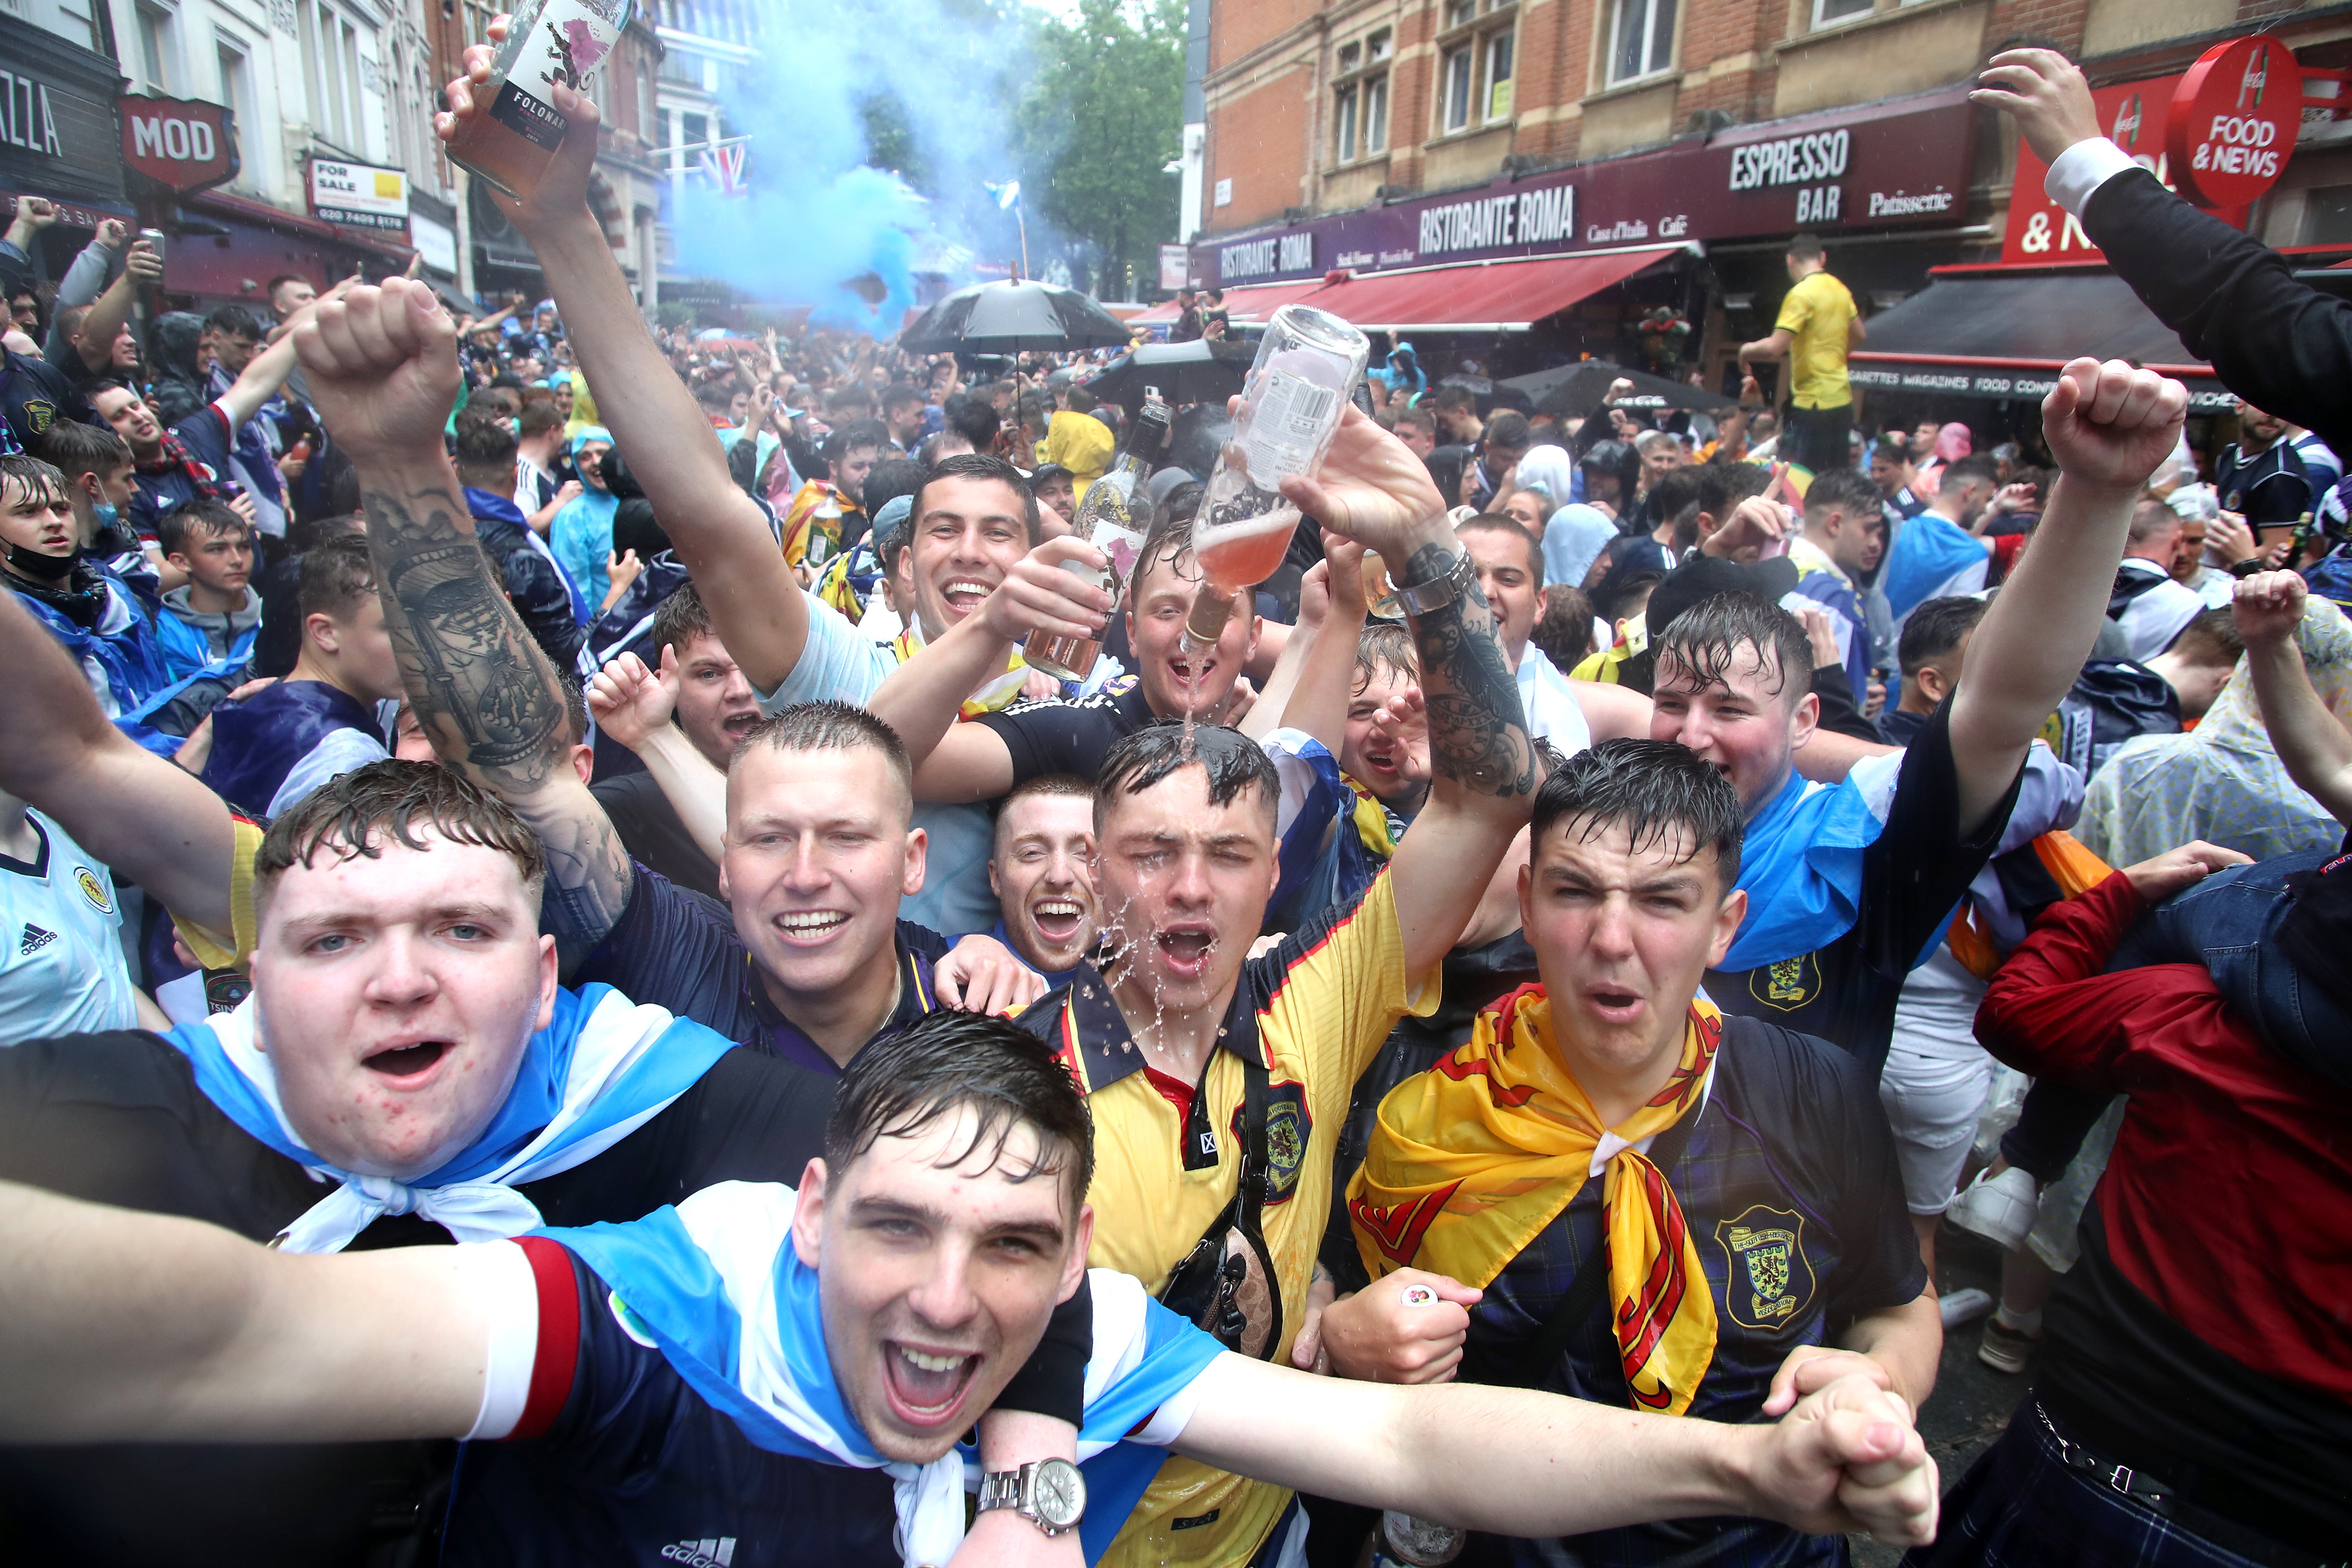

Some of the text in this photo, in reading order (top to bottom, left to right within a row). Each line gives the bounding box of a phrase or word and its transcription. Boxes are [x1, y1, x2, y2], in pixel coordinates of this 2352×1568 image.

[131, 115, 216, 162] MOD
[2208, 114, 2275, 148] FOOD
[318, 163, 347, 176] FOR
[1729, 128, 1849, 191] ESPRESSO
[2191, 143, 2210, 171] &
[2211, 146, 2279, 178] NEWS
[318, 178, 356, 192] SALE
[1796, 185, 1841, 223] BAR
[1868, 185, 1954, 217] Patisserie
[61, 207, 72, 223] &
[319, 208, 344, 221] 020
[345, 211, 376, 226] 7409
[1419, 185, 1574, 255] RISTORANTE ROMA
[1658, 214, 1687, 237] Café
[1587, 225, 1610, 244] Casa
[2021, 211, 2052, 254] &
[1221, 232, 1312, 279] RISTORANTE ROMA
[1902, 374, 1969, 390] MAGAZINES
[1974, 377, 2011, 393] FOOD
[2014, 380, 2058, 394] CONF
[21, 932, 58, 956] adidas
[1273, 1104, 1295, 1114] FOOTBALL
[661, 1544, 722, 1568] adid
